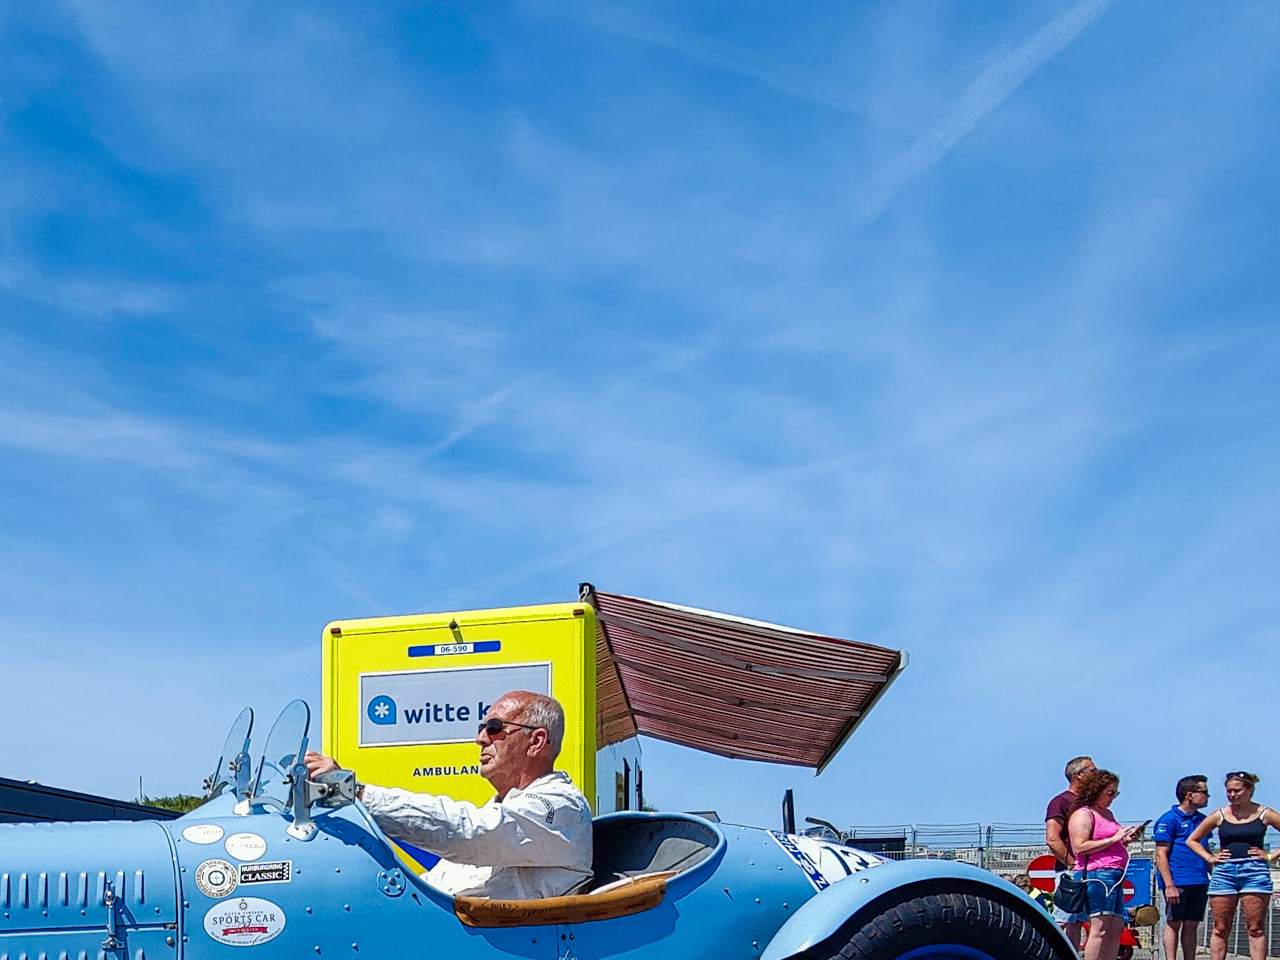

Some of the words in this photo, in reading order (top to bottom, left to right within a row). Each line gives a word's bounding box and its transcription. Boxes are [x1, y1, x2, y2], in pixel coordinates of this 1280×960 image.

[440, 645, 468, 654] 06-590
[404, 702, 470, 724] witte
[478, 701, 492, 720] k
[412, 765, 479, 777] AMBULAN
[241, 871, 283, 881] CLASSIC
[212, 914, 252, 926] SPORTS
[255, 913, 276, 923] CAR
